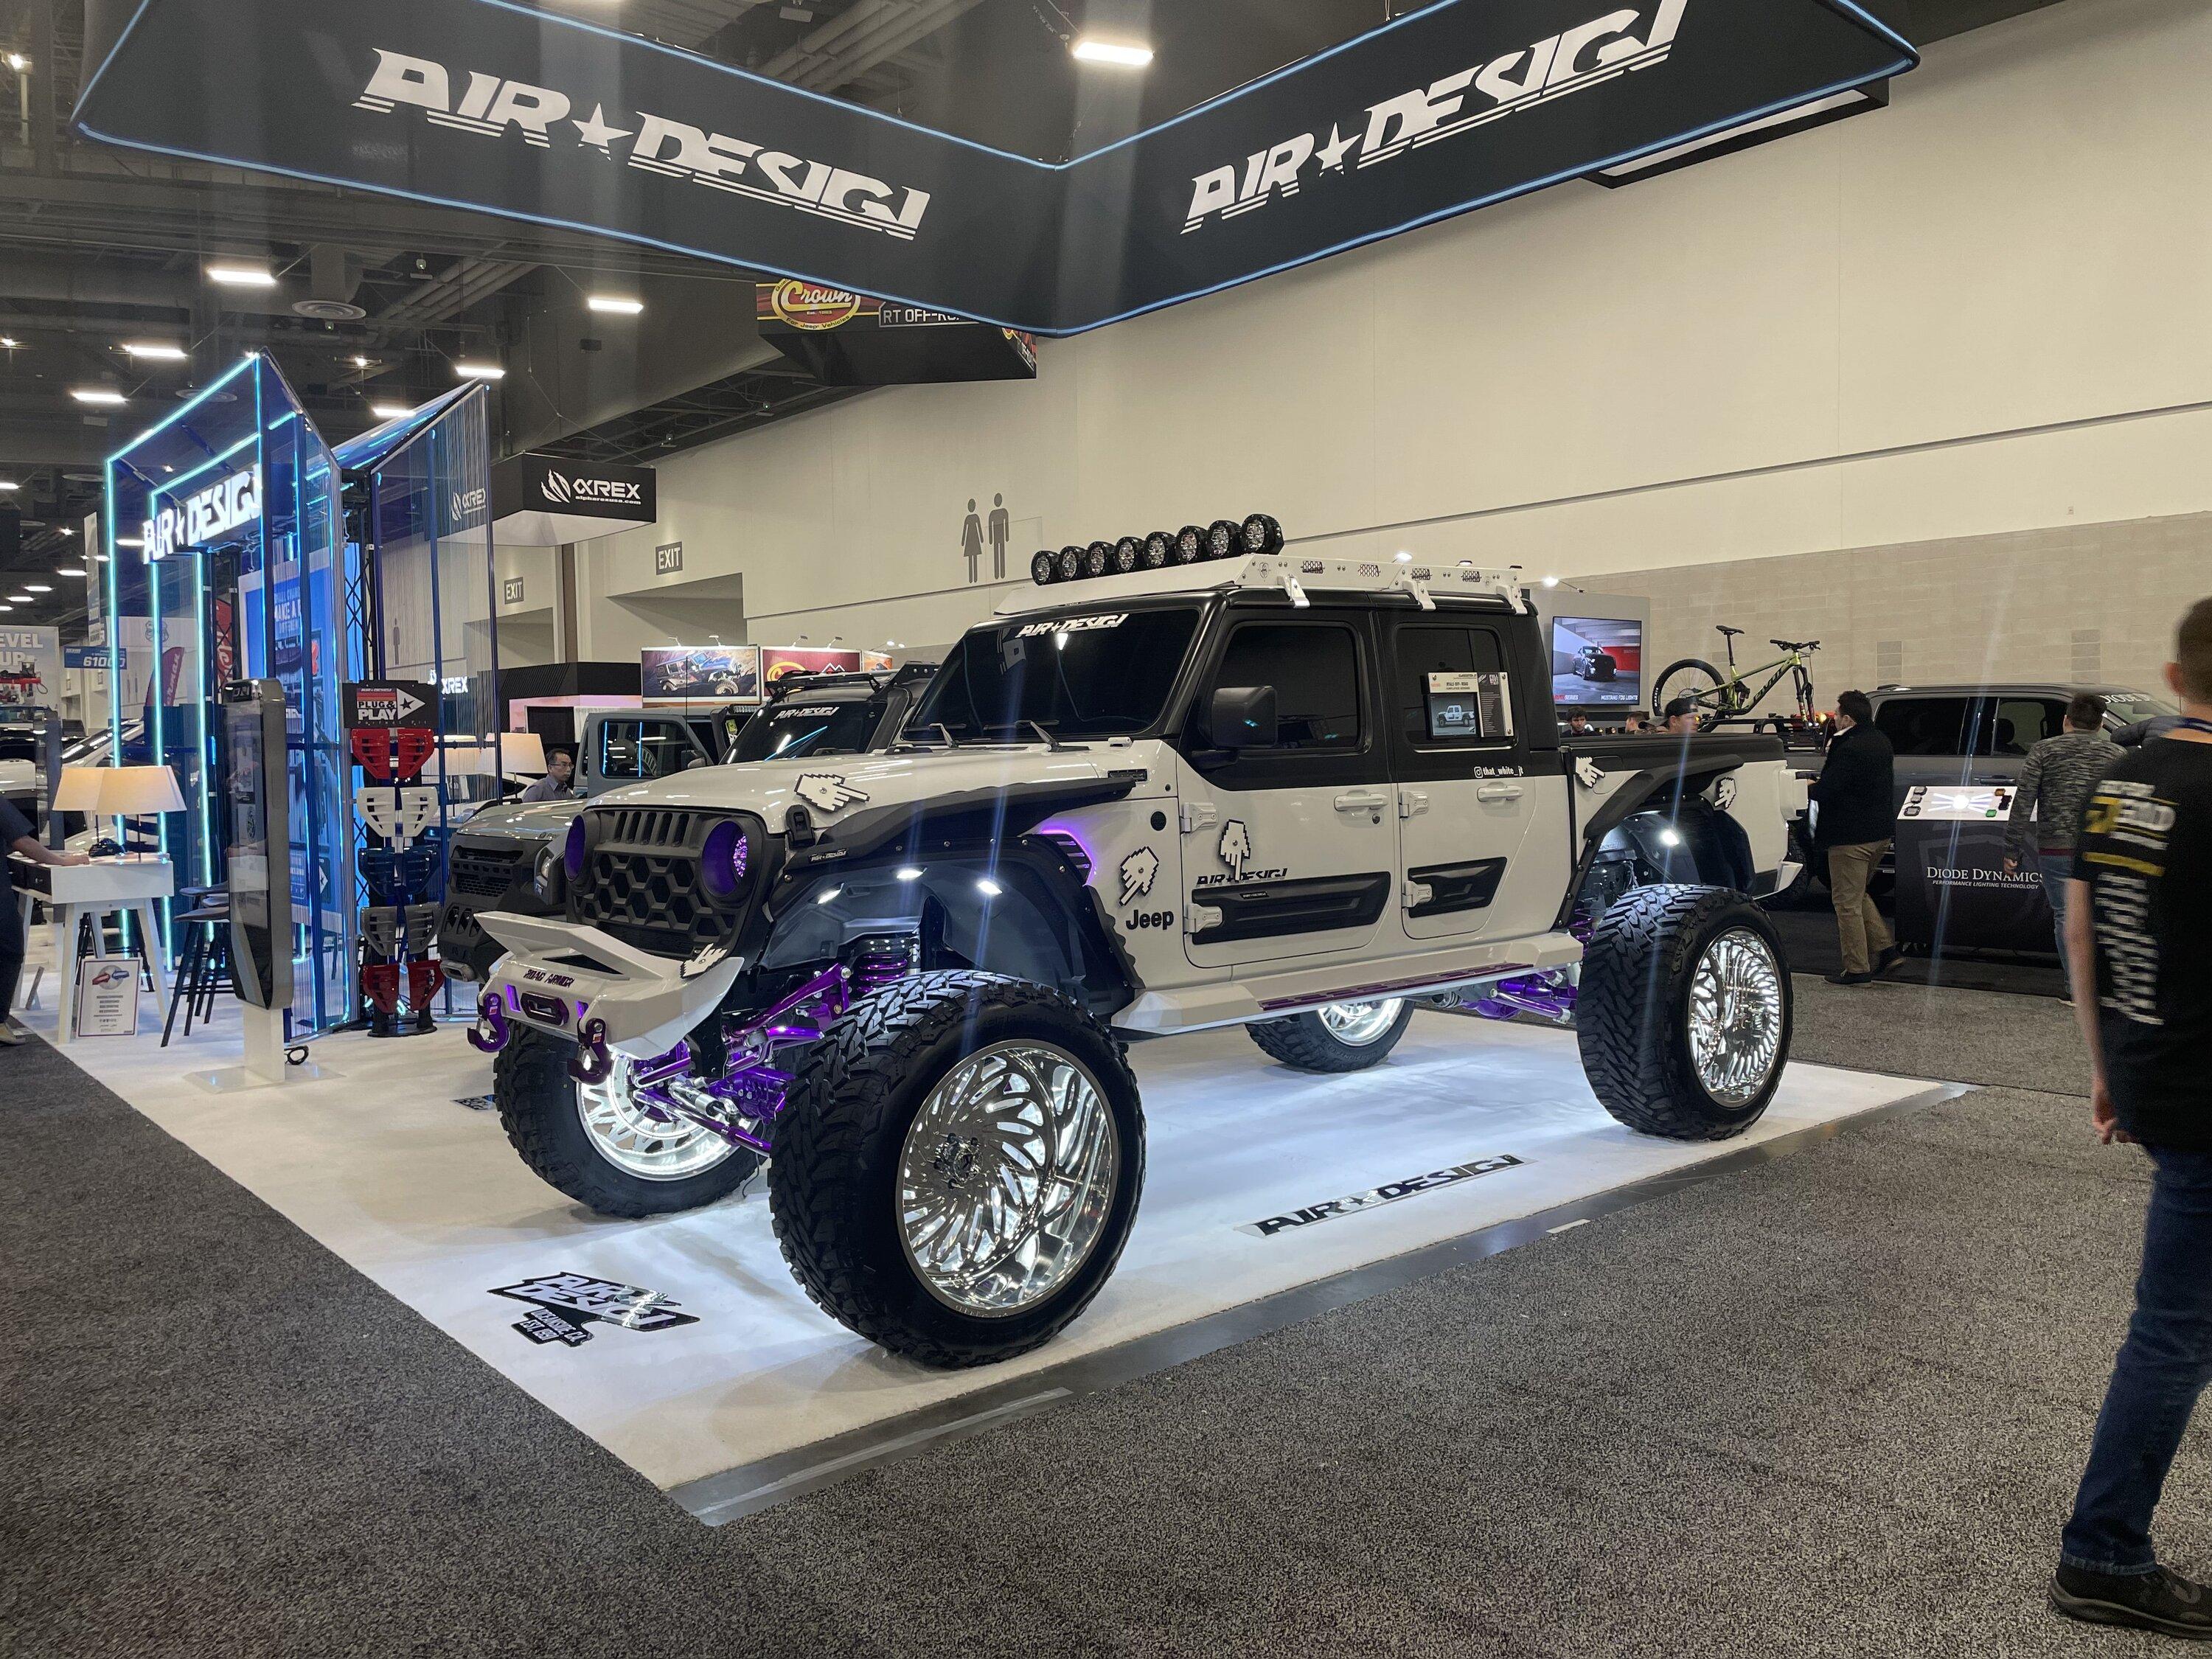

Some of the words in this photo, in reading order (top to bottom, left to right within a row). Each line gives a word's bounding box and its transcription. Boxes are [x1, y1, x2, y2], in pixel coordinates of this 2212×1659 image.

[351, 48, 571, 147] AIR
[1180, 133, 1315, 234] AIR
[781, 281, 852, 312] Crown
[822, 316, 850, 327] Vehicles
[883, 310, 901, 323] RT
[143, 508, 174, 564] AIR
[658, 547, 681, 570] EXIT
[506, 582, 523, 600] EXIT
[1015, 622, 1054, 638] AIR
[358, 709, 397, 720] PLAY
[774, 709, 793, 720] AIR
[1483, 765, 1524, 776] that_white_jt
[1197, 875, 1225, 886] AIR
[1927, 866, 1969, 880] DIODE
[1126, 909, 1174, 931] Jeep
[524, 969, 546, 981] ROAD
[544, 973, 576, 988] ARMOR
[1254, 1201, 1352, 1237] AIR
